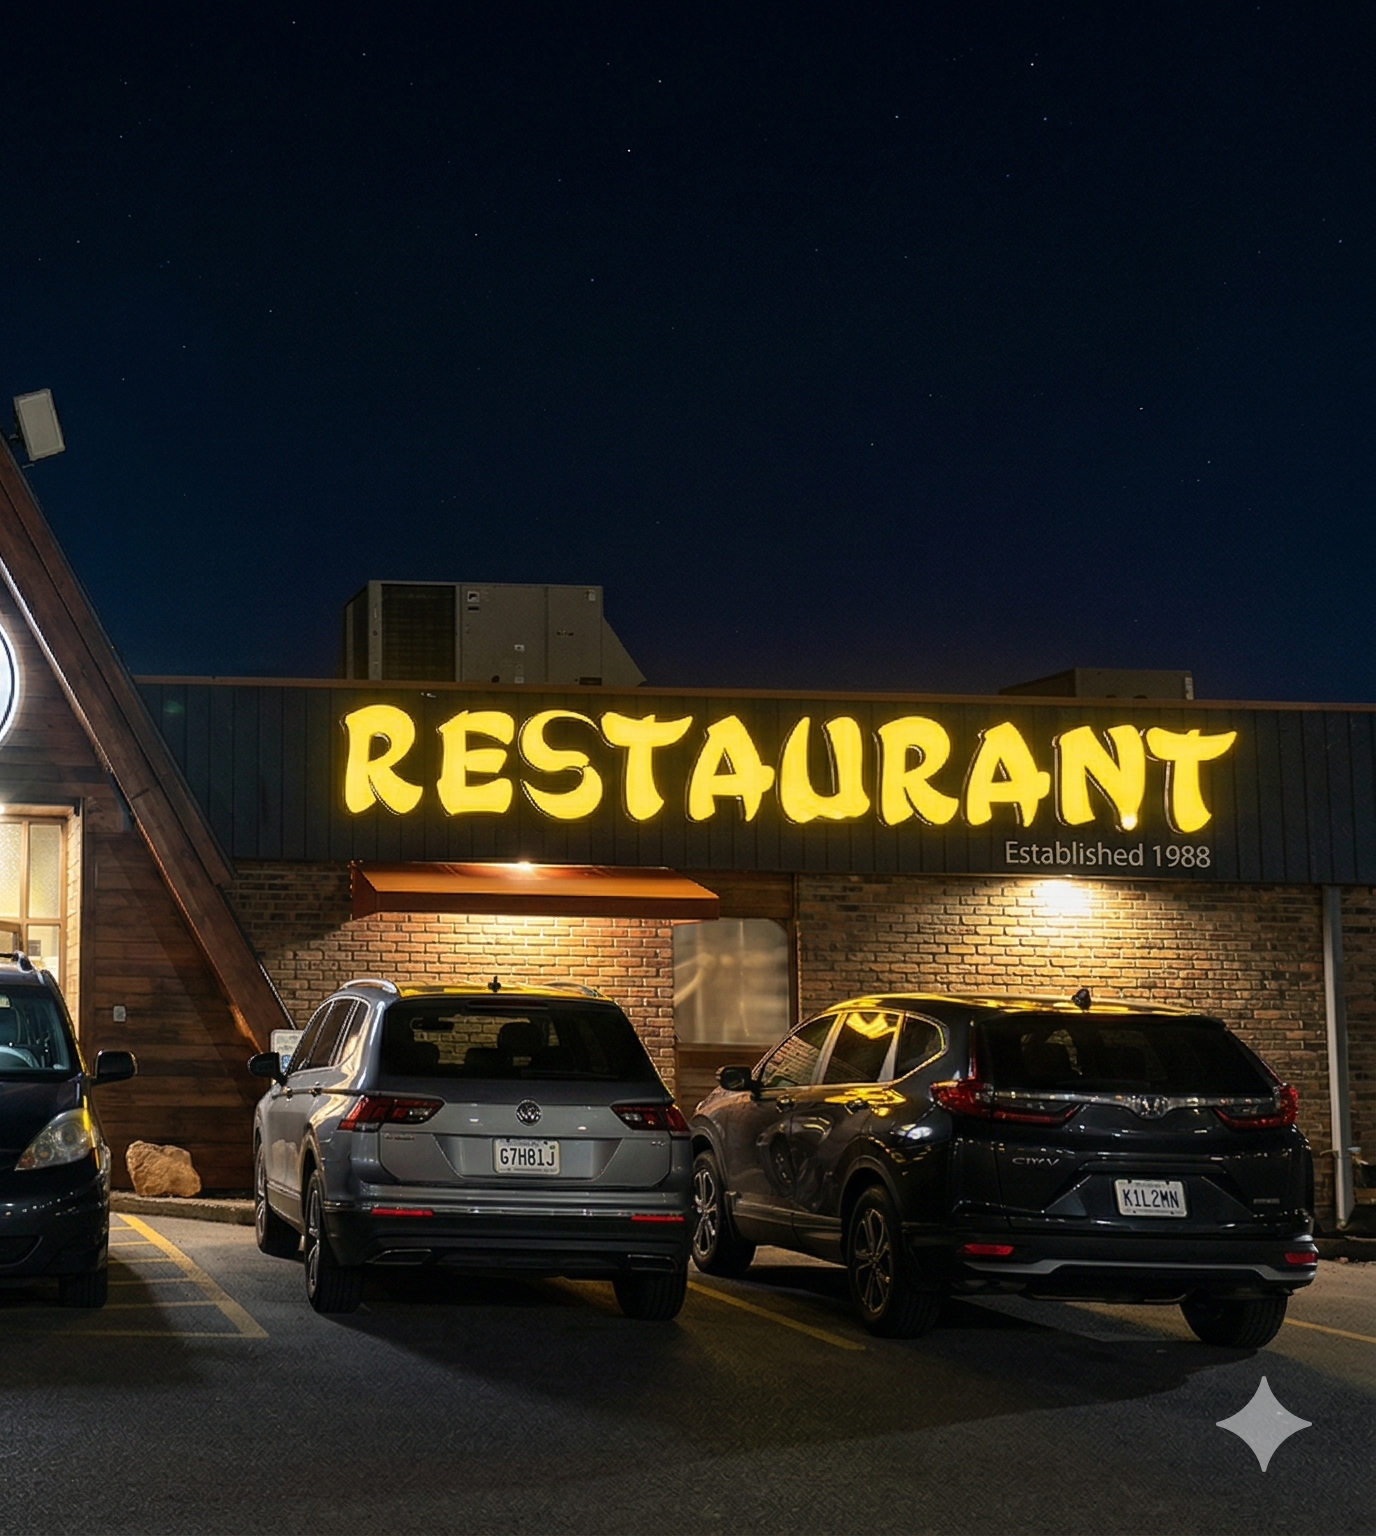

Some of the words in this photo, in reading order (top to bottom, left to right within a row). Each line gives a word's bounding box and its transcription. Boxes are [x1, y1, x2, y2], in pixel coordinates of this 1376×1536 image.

[340, 703, 1238, 834] RESTAURANT
[1005, 840, 1144, 867] Established
[1152, 844, 1211, 868] 1988
[500, 1147, 555, 1167] G7H81J
[1122, 1188, 1180, 1208] K1L2MN
